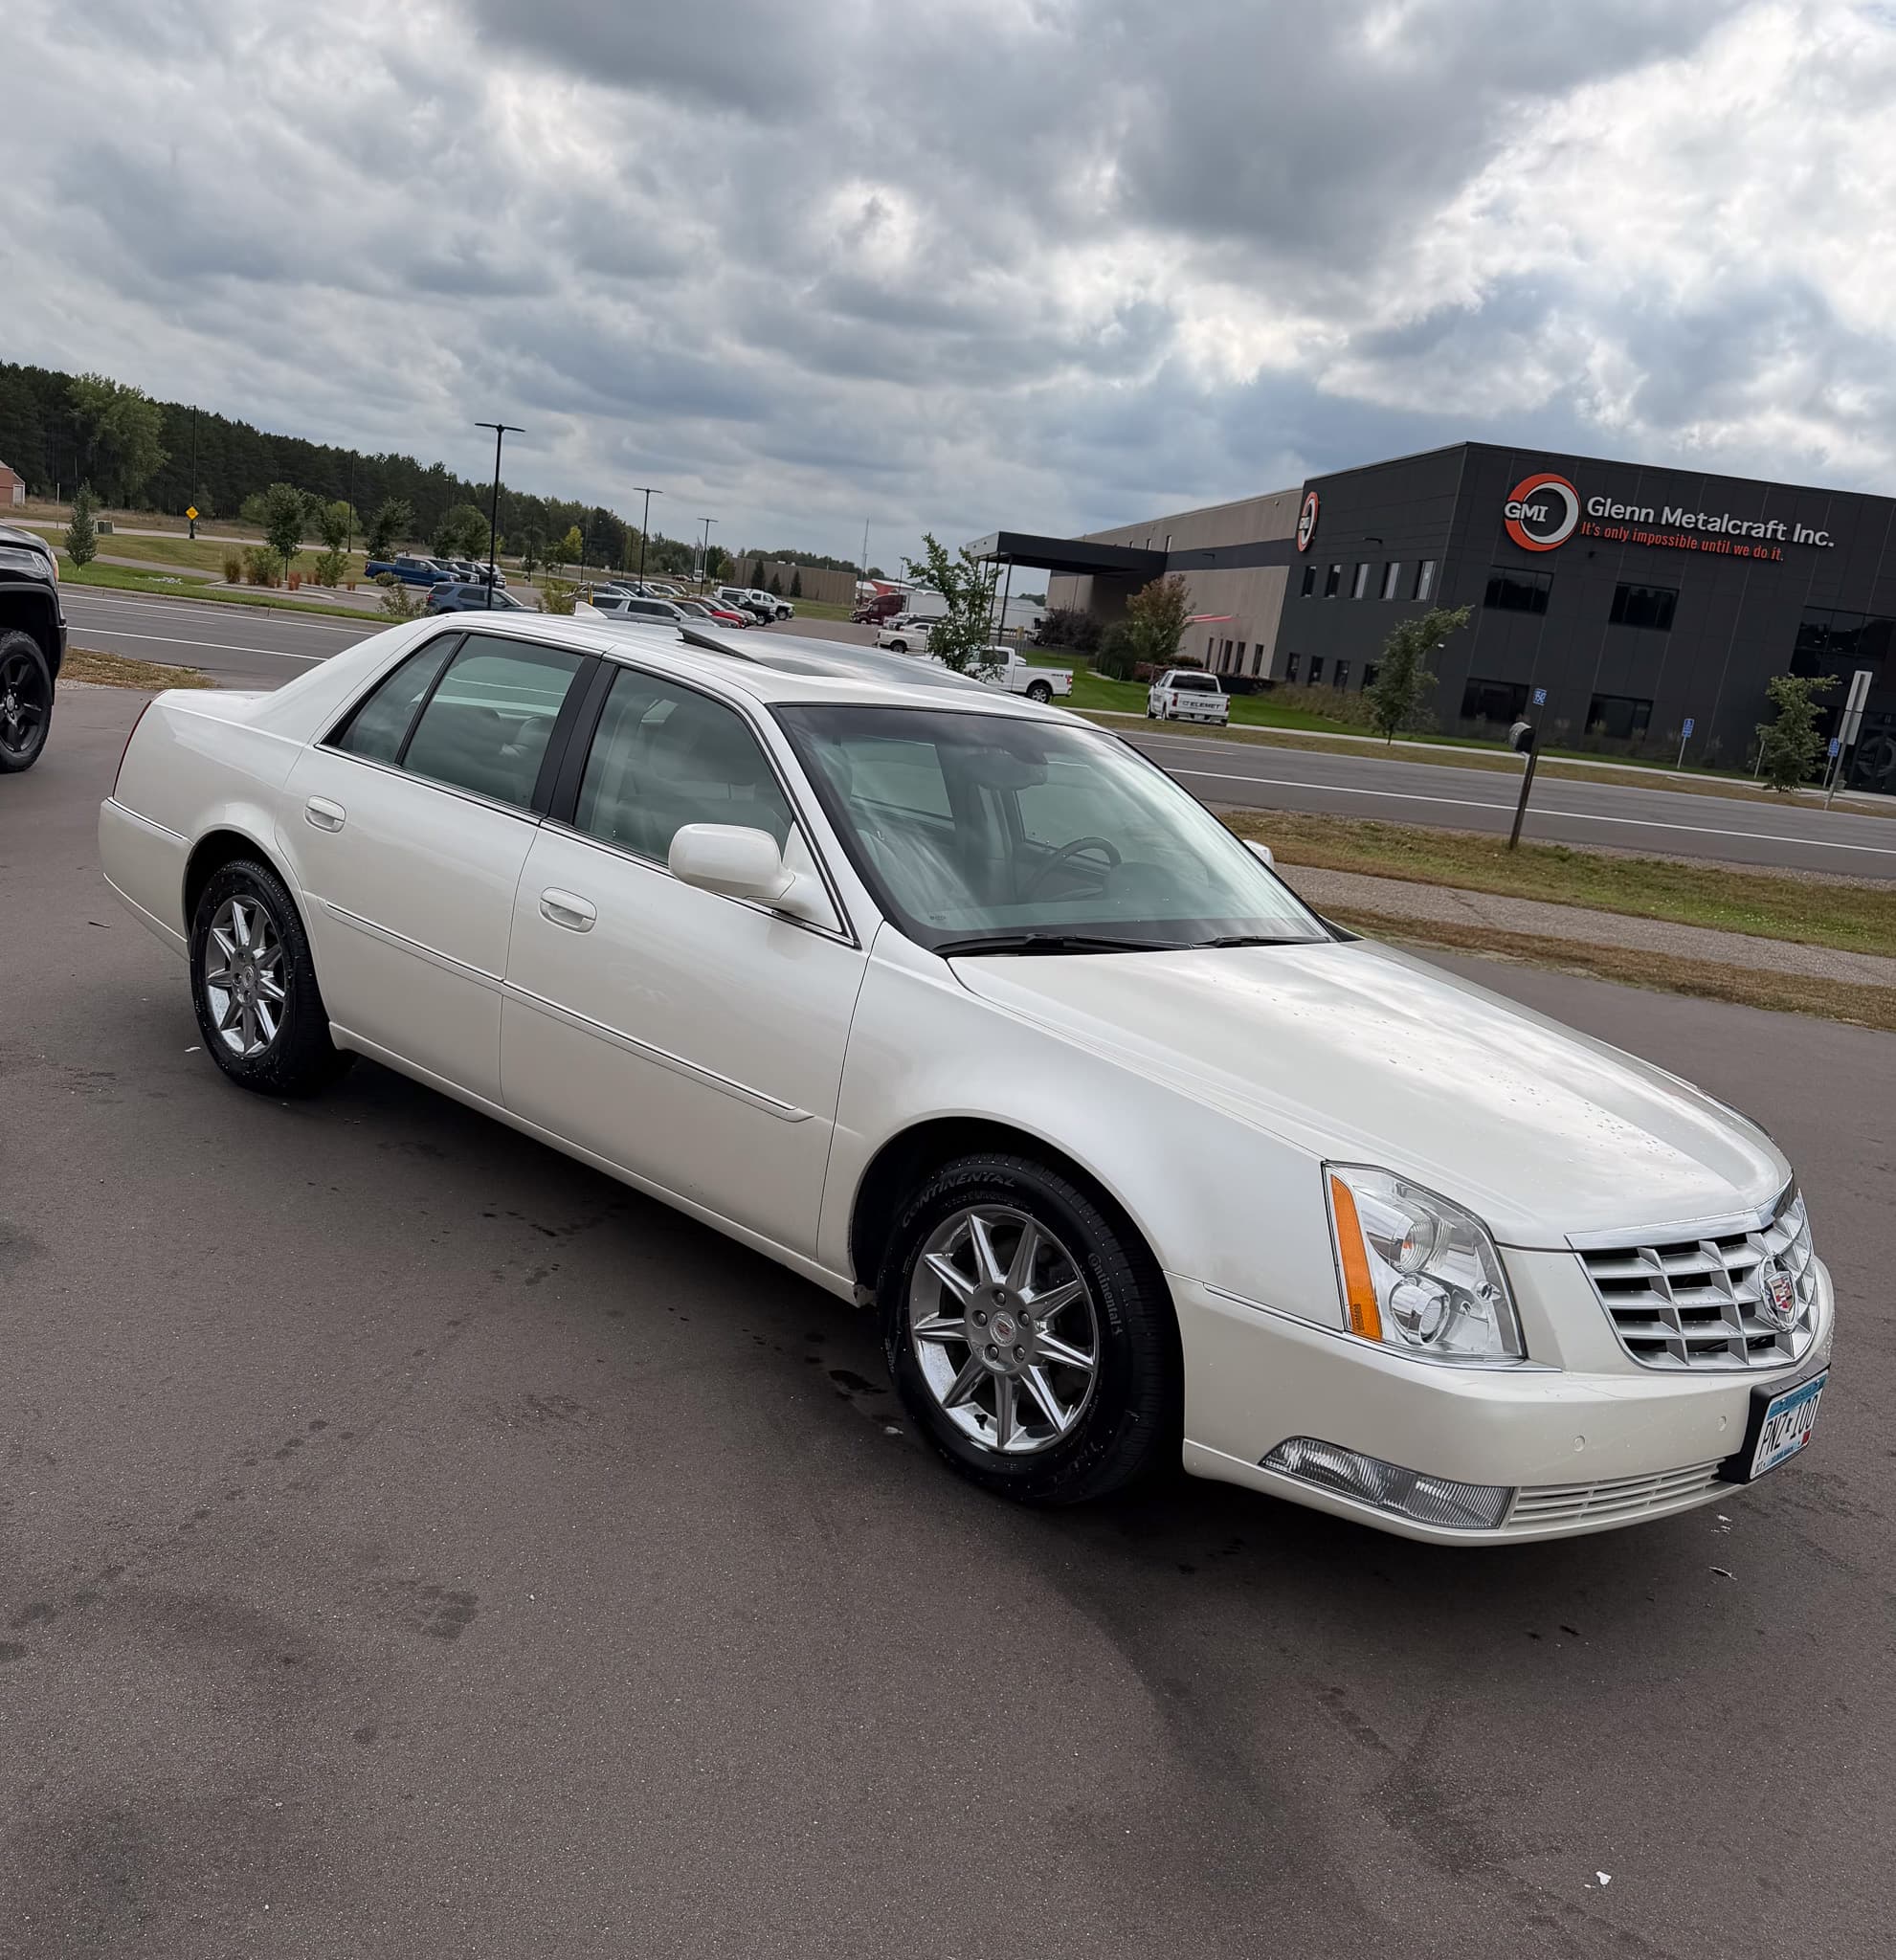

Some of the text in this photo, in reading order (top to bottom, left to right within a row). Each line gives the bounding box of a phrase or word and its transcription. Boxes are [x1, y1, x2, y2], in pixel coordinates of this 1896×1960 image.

[1504, 501, 1549, 523] GMI
[1587, 497, 1835, 547] Glenn Metalcraft Inc.
[1581, 522, 1784, 562] It's only impossible until we do it.
[902, 1171, 1016, 1229] CONTINENTAL
[1087, 1253, 1122, 1325] Continental
[1790, 1393, 1818, 1440] 100
